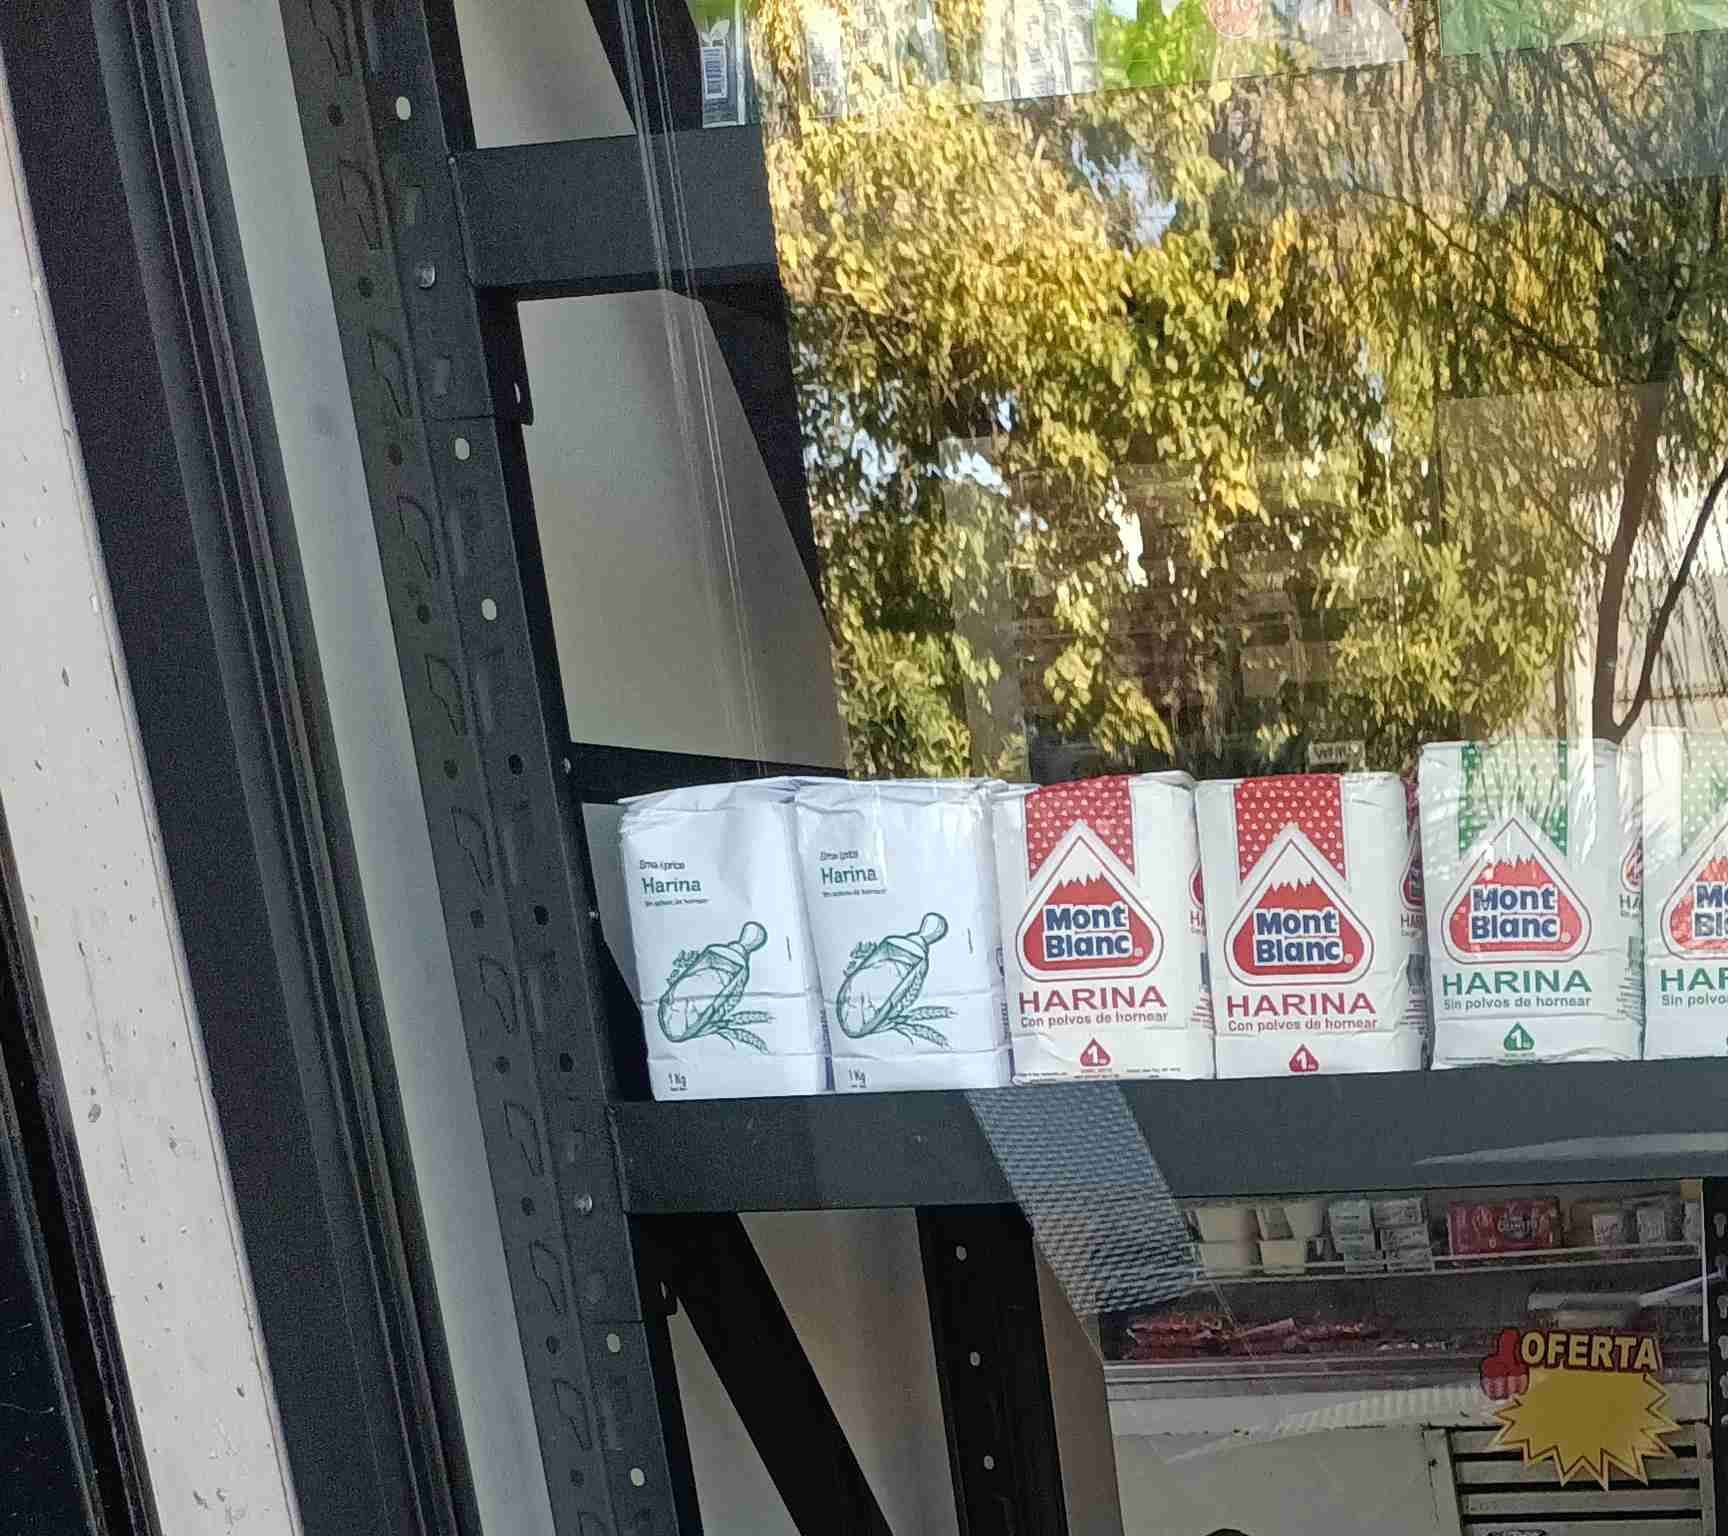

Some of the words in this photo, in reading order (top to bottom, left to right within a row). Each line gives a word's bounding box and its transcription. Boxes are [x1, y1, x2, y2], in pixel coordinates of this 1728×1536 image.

[641, 876, 702, 895] Harina
[820, 866, 878, 885] Harina
[1472, 888, 1555, 912] Mont
[1045, 904, 1127, 932] Mont
[1256, 910, 1337, 935] Mont
[1471, 915, 1557, 939] Blanc
[1045, 933, 1130, 959] Blanc
[1256, 939, 1340, 963] Blanc
[1442, 969, 1592, 997] HARINA
[1019, 986, 1168, 1014] HARINA
[1227, 992, 1376, 1018] HARINA
[1465, 996, 1510, 1012] polvos
[1515, 995, 1531, 1007] de
[1535, 994, 1592, 1008] hornear
[1048, 1014, 1092, 1029] polvos
[1096, 1012, 1112, 1024] de
[1115, 1011, 1168, 1023] hornear
[1257, 1019, 1300, 1033] polvos
[1305, 1018, 1321, 1031] de
[1325, 1018, 1377, 1030] hornear
[1520, 1331, 1658, 1370] OFERTA
